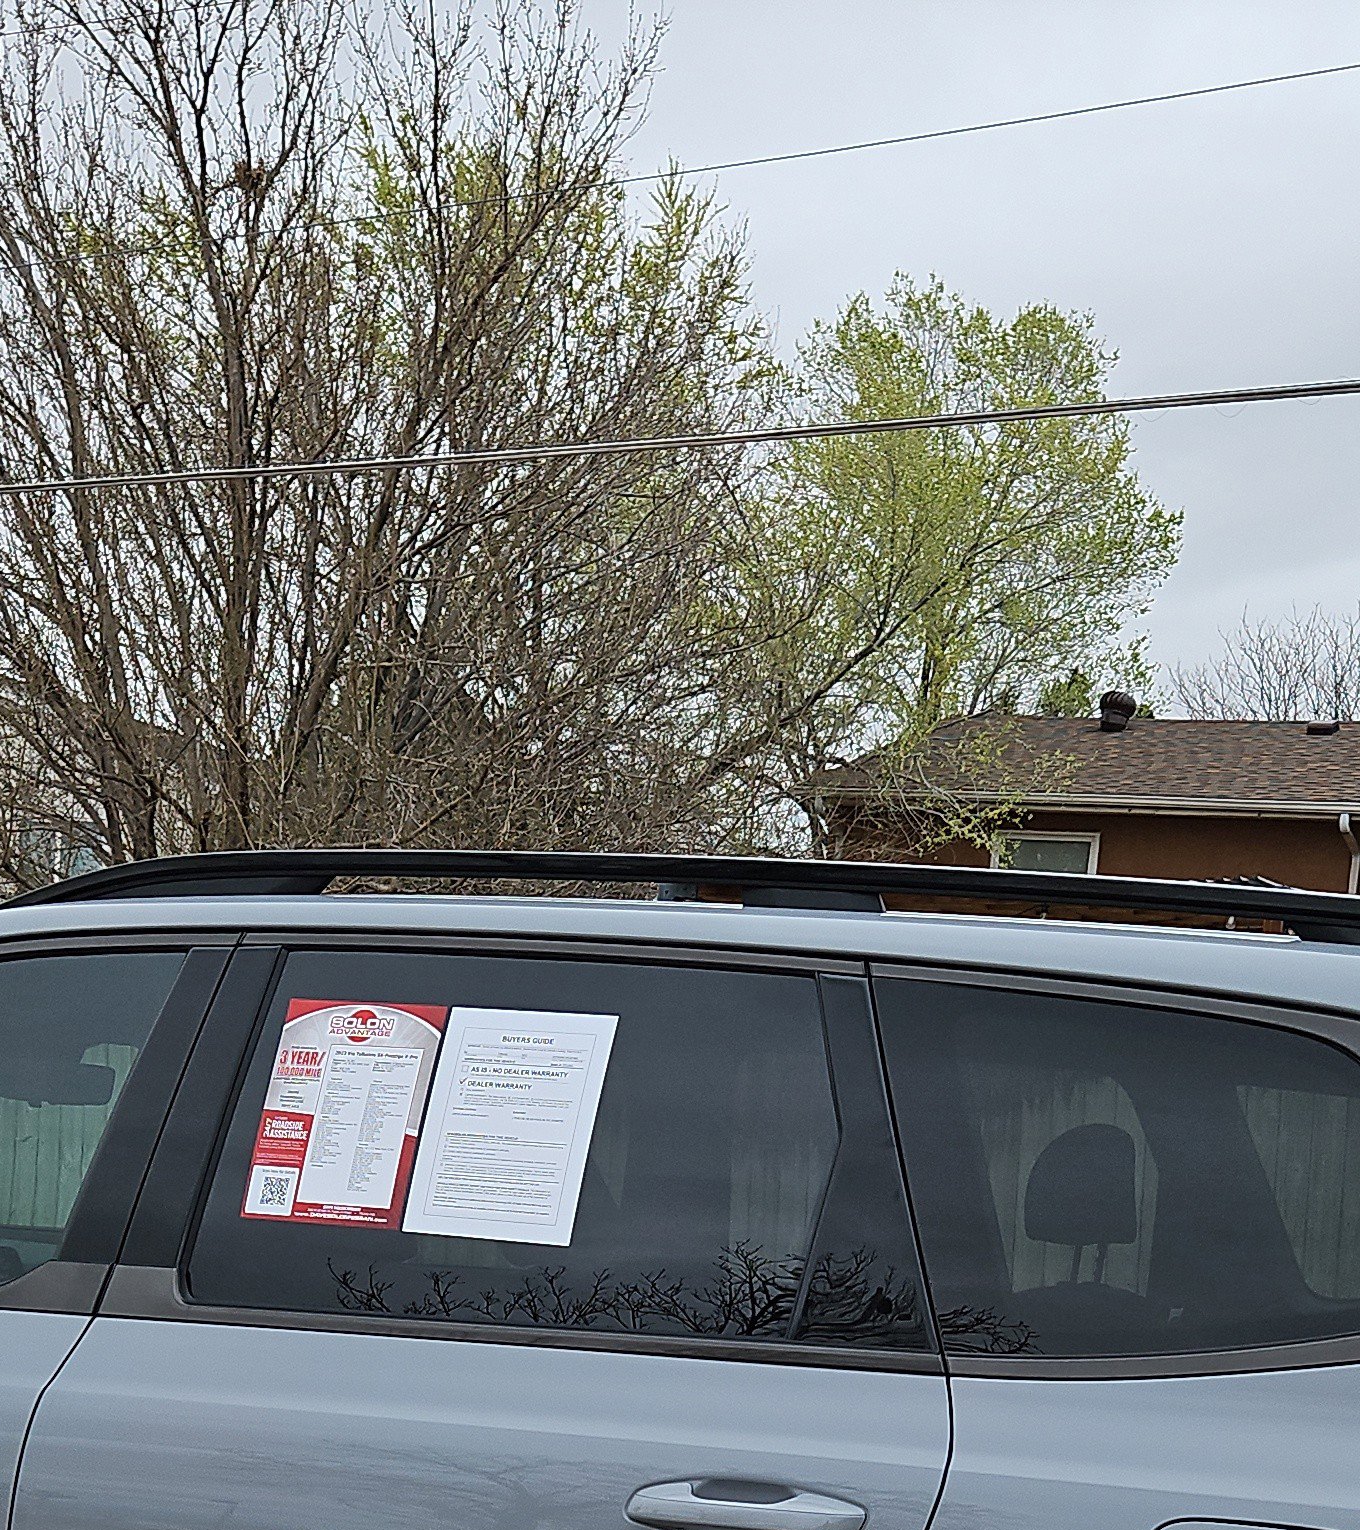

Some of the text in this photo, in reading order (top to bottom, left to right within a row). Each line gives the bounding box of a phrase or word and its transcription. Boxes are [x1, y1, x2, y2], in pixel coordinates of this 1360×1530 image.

[330, 1015, 395, 1030] SOLON
[328, 1028, 391, 1037] ADVANTAGE
[501, 1035, 555, 1045] BUYERS GUIDE
[280, 1049, 289, 1064] 3
[290, 1050, 327, 1067] YEAR/
[503, 1068, 530, 1076] DEALER
[531, 1069, 569, 1078] WARRANTY
[467, 1080, 533, 1090] DEALER WARRANTY
[271, 1119, 305, 1131] ROADSIDE
[269, 1128, 309, 1140] ASSISTANCE
